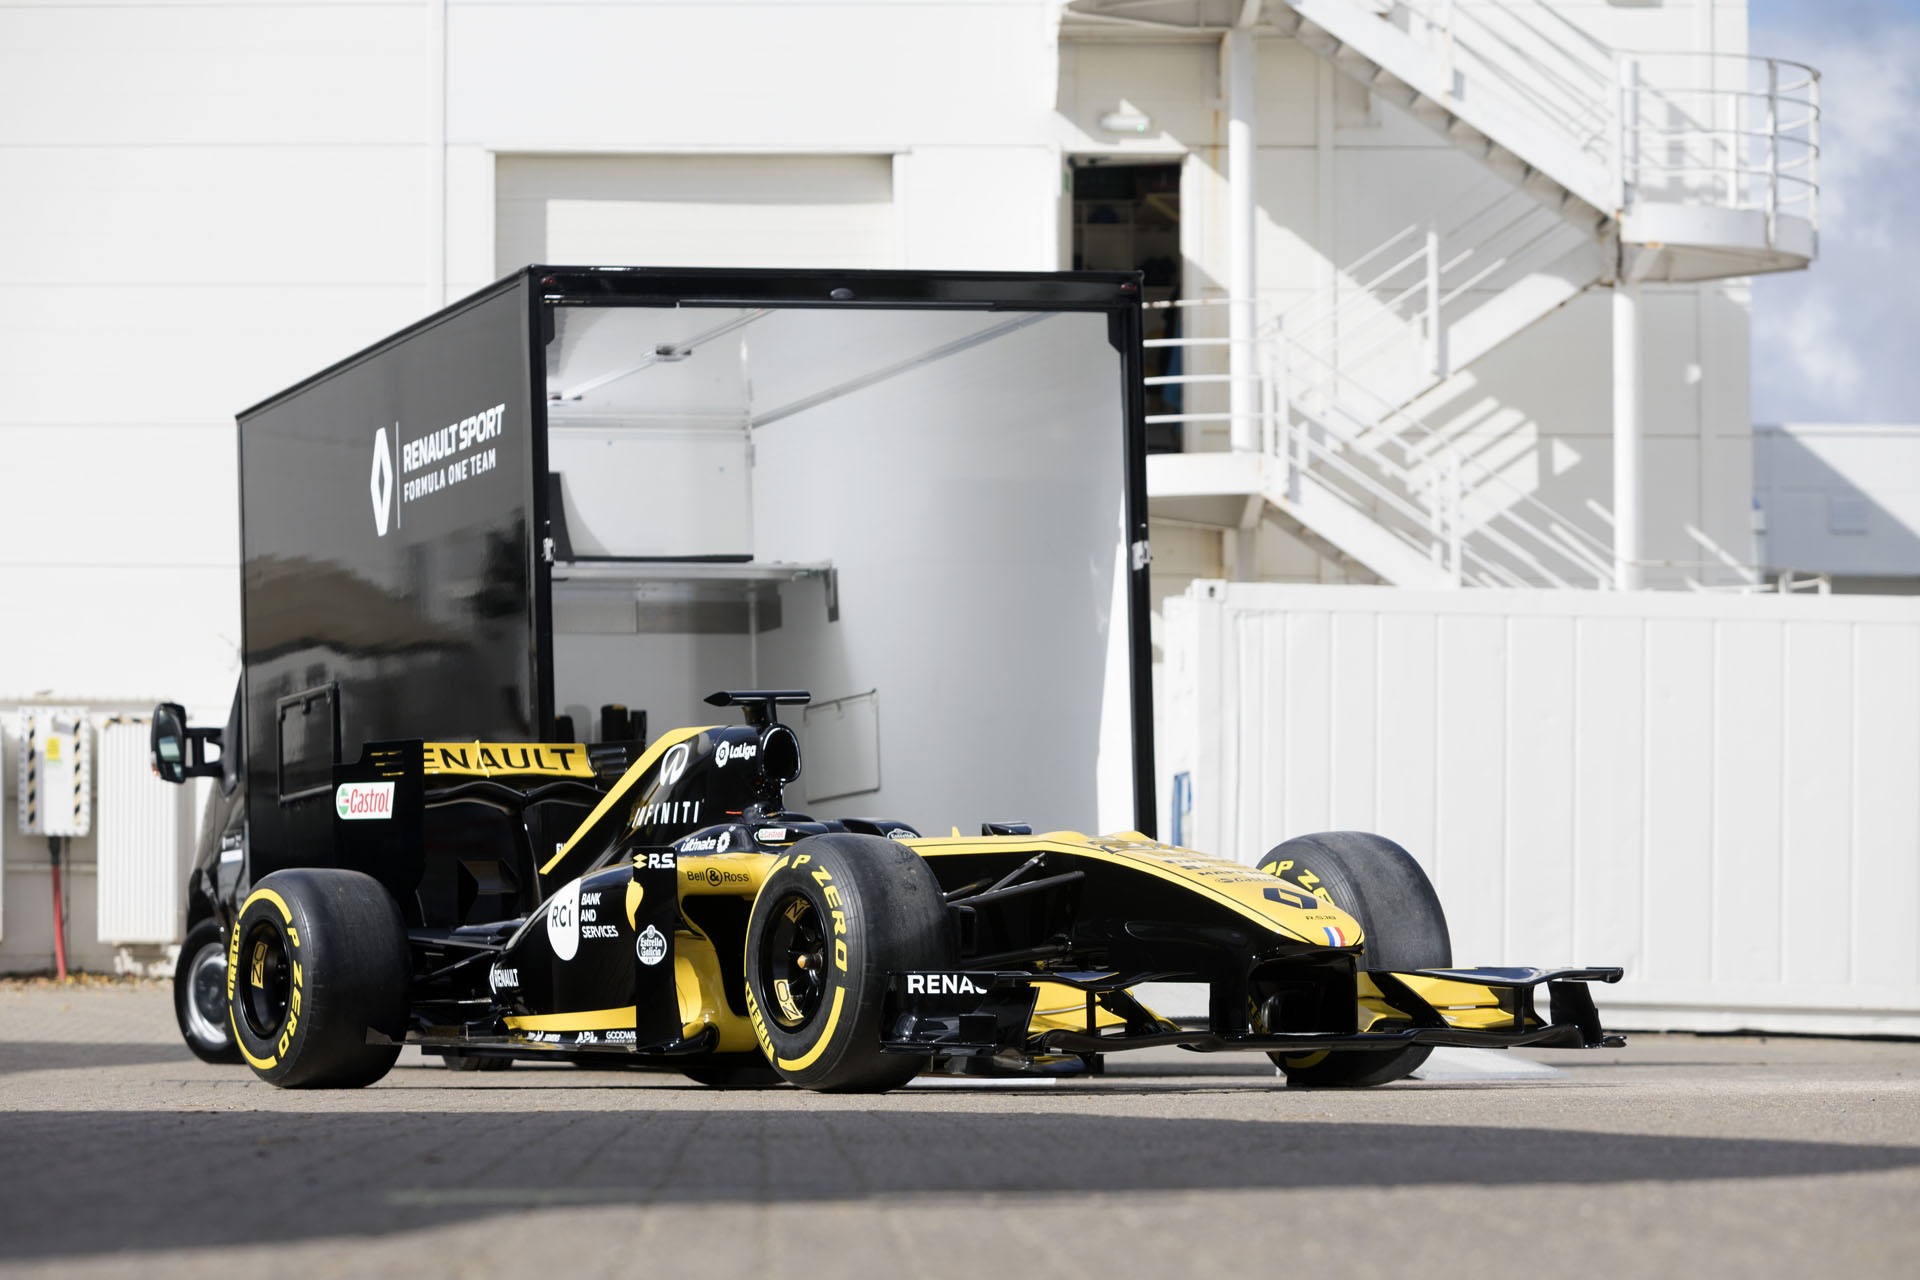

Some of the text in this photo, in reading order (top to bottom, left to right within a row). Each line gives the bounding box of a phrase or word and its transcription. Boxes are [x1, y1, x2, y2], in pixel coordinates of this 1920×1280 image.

[403, 403, 505, 473] RENAULT SPORT
[404, 448, 497, 503] FORMULA ONE TEAM
[424, 748, 575, 771] ENAULT
[729, 742, 757, 760] LaLiga
[350, 787, 390, 814] Castrol
[631, 801, 700, 828] INFINITI
[680, 837, 717, 852] ultimate
[687, 871, 705, 882] Bell
[723, 871, 749, 882] Ross
[1275, 860, 1336, 906] P ZE
[581, 893, 601, 905] BANK
[581, 909, 597, 922] AND
[791, 854, 848, 972] P ZERO
[581, 925, 619, 938] SERVICES
[640, 937, 663, 947] Estrella
[640, 946, 661, 956] Galicia
[494, 968, 519, 988] RENAULT
[278, 927, 303, 1058] P ZERO
[605, 1031, 637, 1039] GOODWIL
